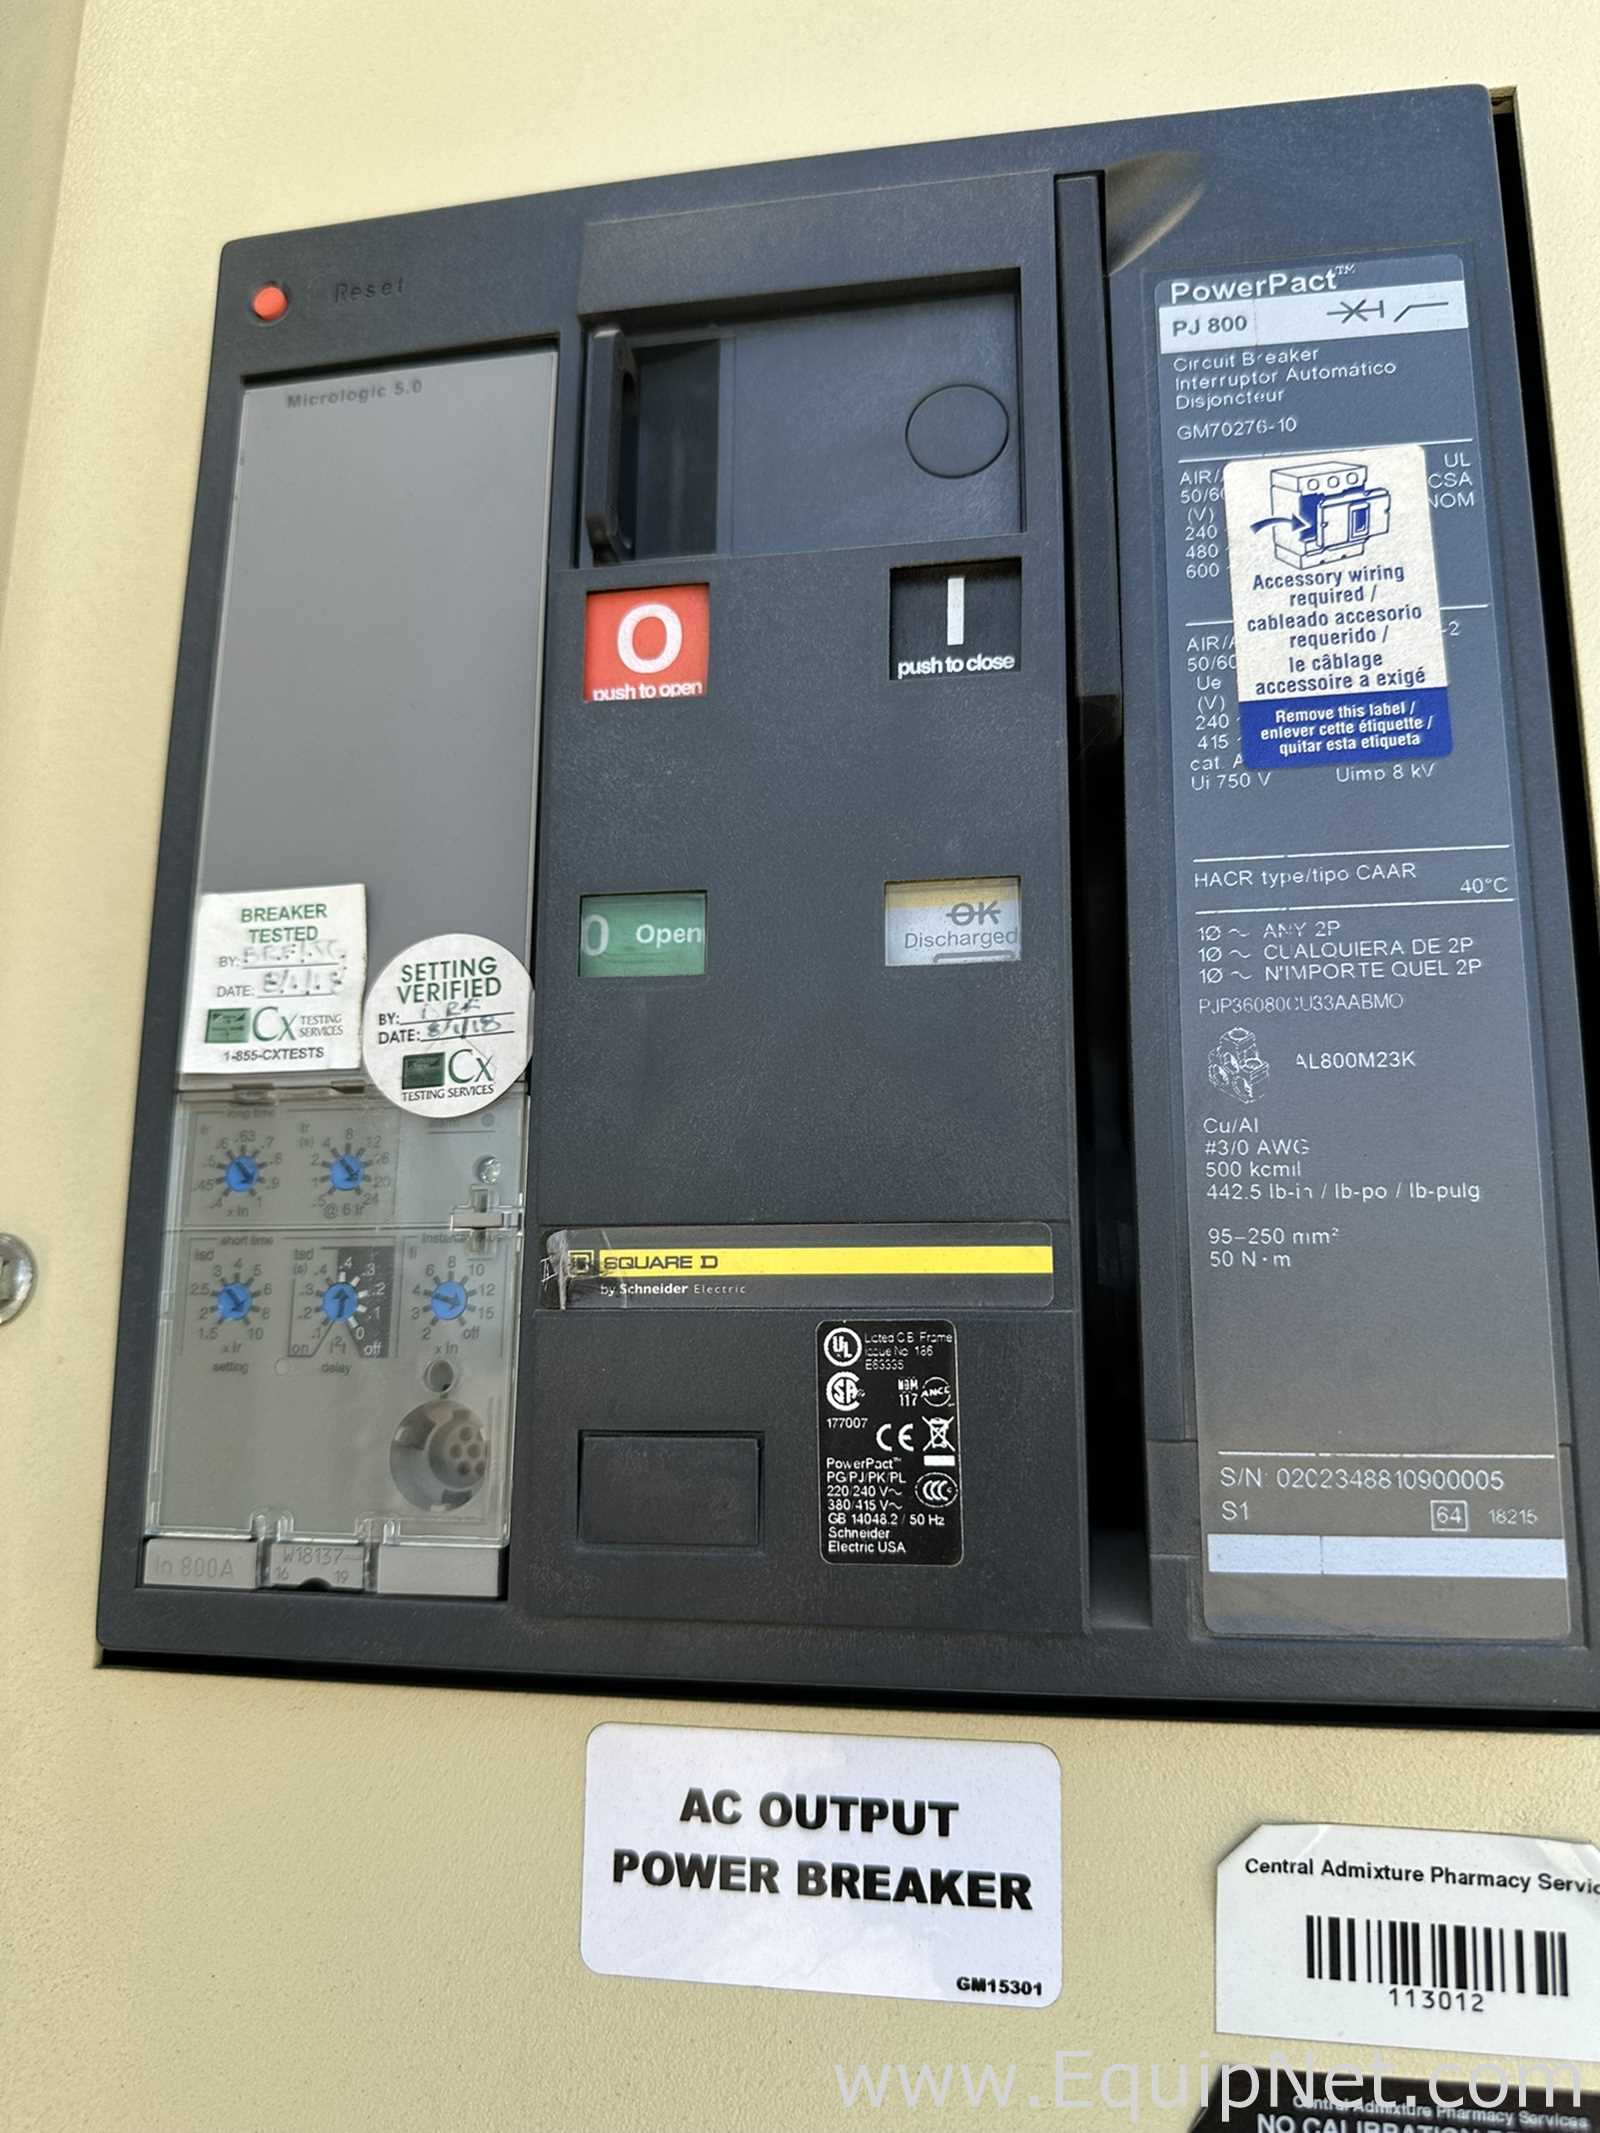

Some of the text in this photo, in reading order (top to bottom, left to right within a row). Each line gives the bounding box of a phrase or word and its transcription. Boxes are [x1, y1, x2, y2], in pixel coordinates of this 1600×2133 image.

[335, 277, 403, 302] Reset
[1172, 315, 1248, 337] PJ 800
[1173, 348, 1320, 373] Circuit Breaker
[1175, 361, 1397, 391] Interruptor Automático
[286, 379, 423, 409] Micrologic 5.0
[1176, 389, 1285, 412] Disjoncteur
[1176, 416, 1297, 440] GM70276-10
[1444, 452, 1472, 468] UL
[1428, 471, 1473, 489] CSA
[1188, 506, 1214, 525] (V)
[1185, 525, 1218, 541] 240
[1185, 543, 1218, 560] 480
[1186, 562, 1220, 579] 600
[1252, 564, 1405, 591] Accessory wiring
[1289, 586, 1365, 609] required
[1247, 604, 1423, 633] cableado accesorio
[1289, 628, 1376, 650] requerido
[898, 654, 1016, 680] push to close
[1289, 650, 1383, 673] le câblage
[592, 681, 703, 701] push to open
[1196, 675, 1222, 691] Ue
[1255, 666, 1426, 696] accessoire a exigé
[1198, 695, 1225, 714] (V)
[1275, 701, 1405, 724] Remove this label
[1195, 714, 1230, 731] 240
[1260, 717, 1424, 741] enlever cette étiquette
[1197, 734, 1229, 750] 415
[1279, 733, 1421, 757] quitar esta etiqueta
[1393, 764, 1404, 780] 8
[1411, 762, 1436, 778] kV
[1191, 772, 1271, 791] Ui 750 V
[1194, 862, 1417, 889] HACR type/tipo CAAR
[1460, 877, 1509, 894] 40°C
[241, 903, 328, 923] BREAKER
[950, 900, 1001, 926] OK
[249, 926, 318, 943] TESTED
[636, 923, 704, 949] Open
[905, 926, 1018, 949] Discharged
[1263, 920, 1341, 938] ANY 2P
[1412, 938, 1441, 955] DE
[1448, 936, 1474, 953] 2P
[219, 956, 240, 967] BY:
[401, 957, 497, 983] SETTING
[1265, 958, 1482, 981] N'IMPORTE QUEL 2P
[217, 985, 255, 998] DATE:
[397, 976, 502, 1004] VERIFIED
[252, 1006, 342, 1042] Cx TESTING
[378, 1012, 400, 1026] BY:
[300, 1025, 343, 1038] SERVICES
[378, 1029, 421, 1045] DATE:
[223, 1047, 324, 1062] 1-855-CXTESTS
[1295, 1050, 1416, 1070] AL800M23K
[448, 1049, 494, 1084] Cx
[401, 1084, 495, 1102] TESTING SERVICES
[1203, 1117, 1259, 1135] Cu/Al
[1204, 1138, 1311, 1157] #3/0 AWG
[1205, 1160, 1302, 1178] 500 kcmil
[1206, 1182, 1480, 1202] 442.5 lb-in lb-po lb-pulg
[603, 1255, 718, 1270] SQUARE D
[1209, 1251, 1233, 1268] 50
[600, 1283, 746, 1296] by Schneider Electric
[463, 1326, 480, 1339] off
[826, 1417, 868, 1429] 177007
[828, 1512, 846, 1524] GB
[910, 1513, 925, 1525] 50
[928, 1514, 945, 1526] Hz
[1222, 1500, 1538, 1526] S1 64 18215
[828, 1526, 890, 1539] Schneider
[828, 1540, 906, 1554] Electric USA
[181, 1556, 234, 1578] 800A
[679, 1787, 960, 1838] AC OUTPUT
[612, 1848, 1034, 1911] POWER BREAKER
[1245, 1857, 1314, 1876] Central
[1321, 1859, 1425, 1883] Admixture
[1430, 1866, 1531, 1893] Pharmacy
[956, 1976, 1043, 1997] GM15301
[1390, 1987, 1485, 2013] 113012
[1257, 2112, 1296, 2133] NO
[1436, 2106, 1590, 2130] Pharmacy Services
